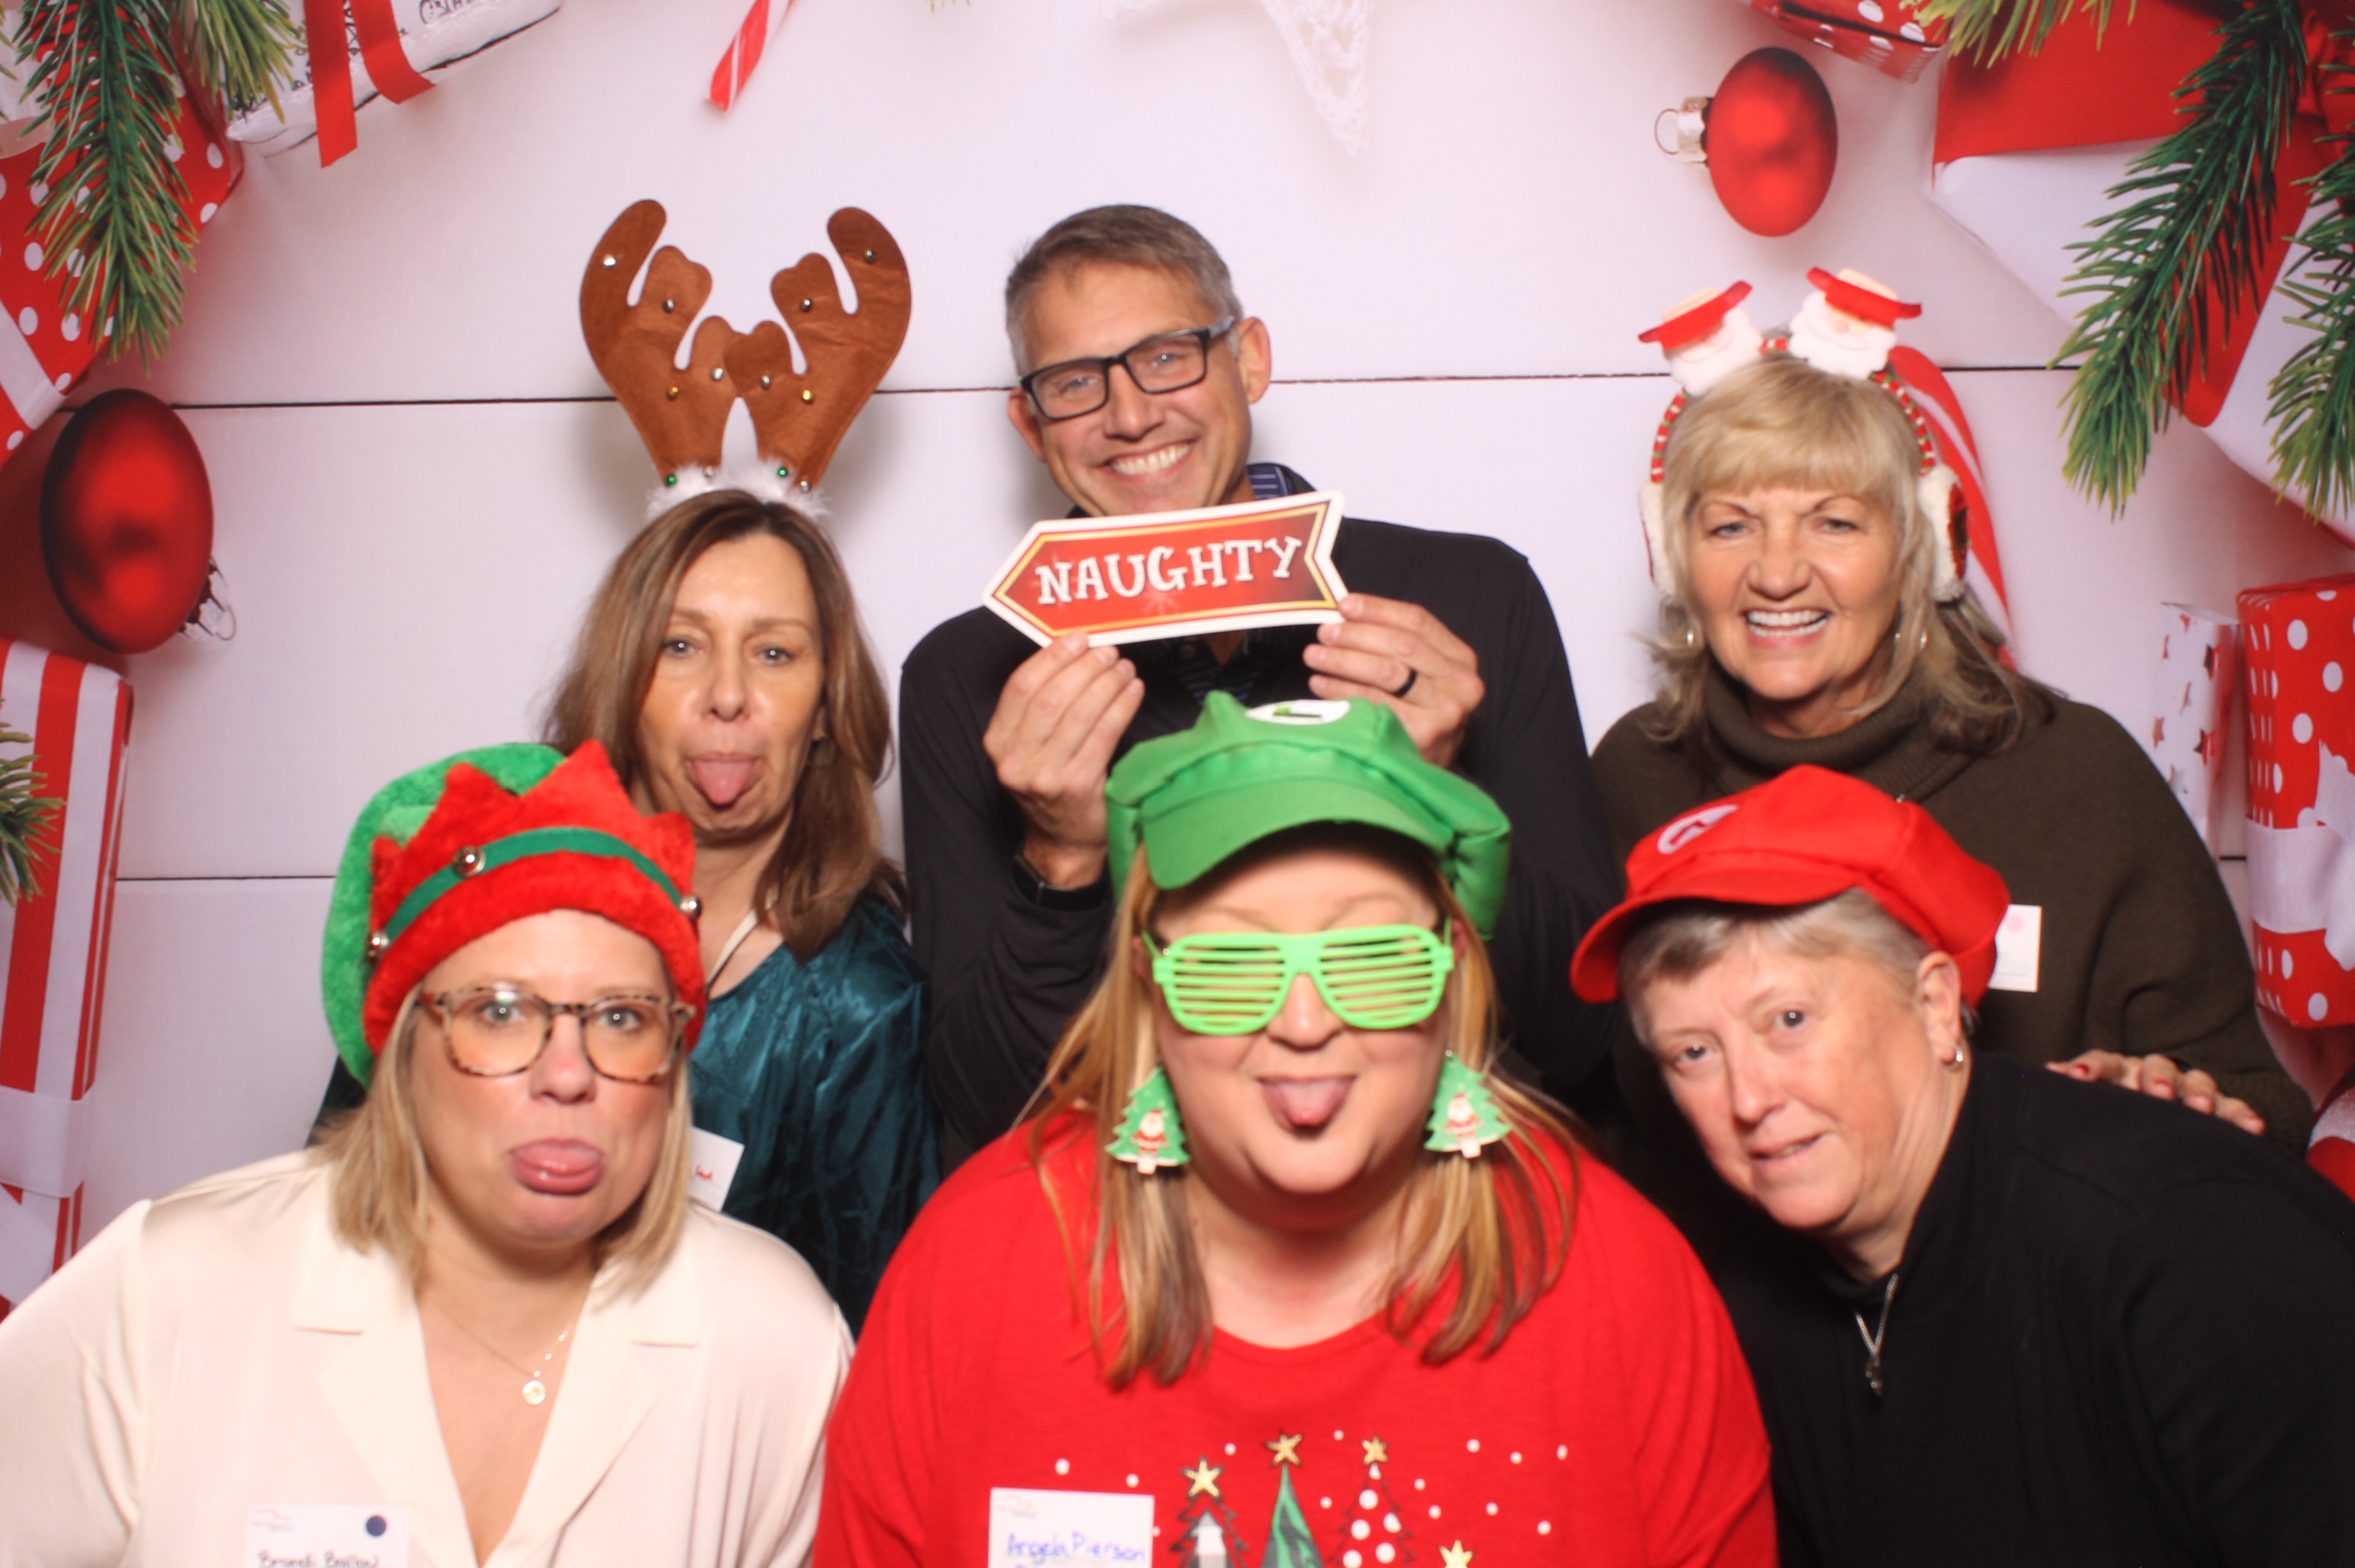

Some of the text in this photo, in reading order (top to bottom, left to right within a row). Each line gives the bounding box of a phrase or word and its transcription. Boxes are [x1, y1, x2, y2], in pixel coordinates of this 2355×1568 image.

[1035, 536, 1302, 605] NAUGHTY
[1007, 1531, 1145, 1566] Angela Pierson
